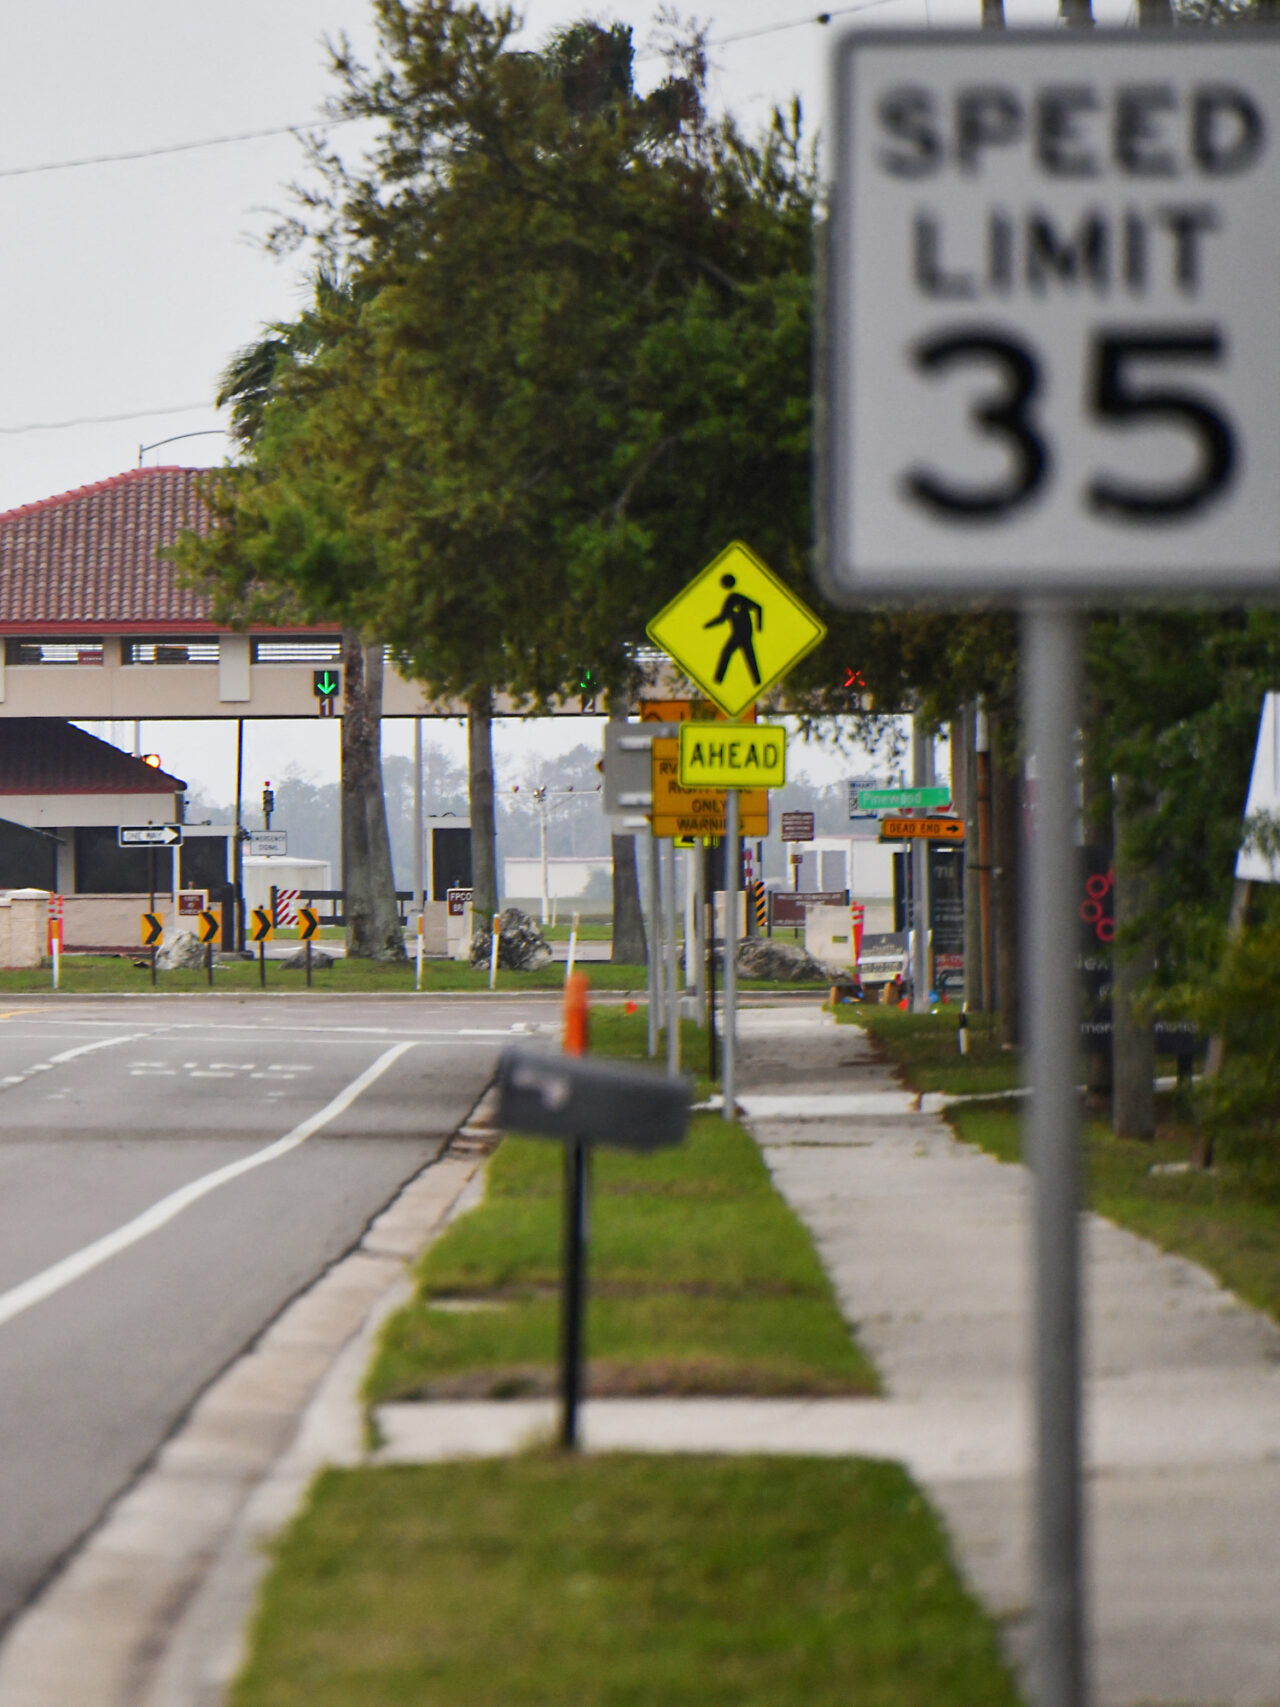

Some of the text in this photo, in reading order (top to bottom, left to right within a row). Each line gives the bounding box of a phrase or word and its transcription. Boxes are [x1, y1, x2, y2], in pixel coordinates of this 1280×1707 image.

[876, 84, 1265, 180] SPEED
[910, 205, 1226, 296] LIMIT
[900, 318, 1242, 530] 35
[321, 698, 329, 716] 1
[689, 743, 778, 769] AHEAD
[677, 817, 745, 832] WARNI
[889, 823, 940, 834] DEAD END
